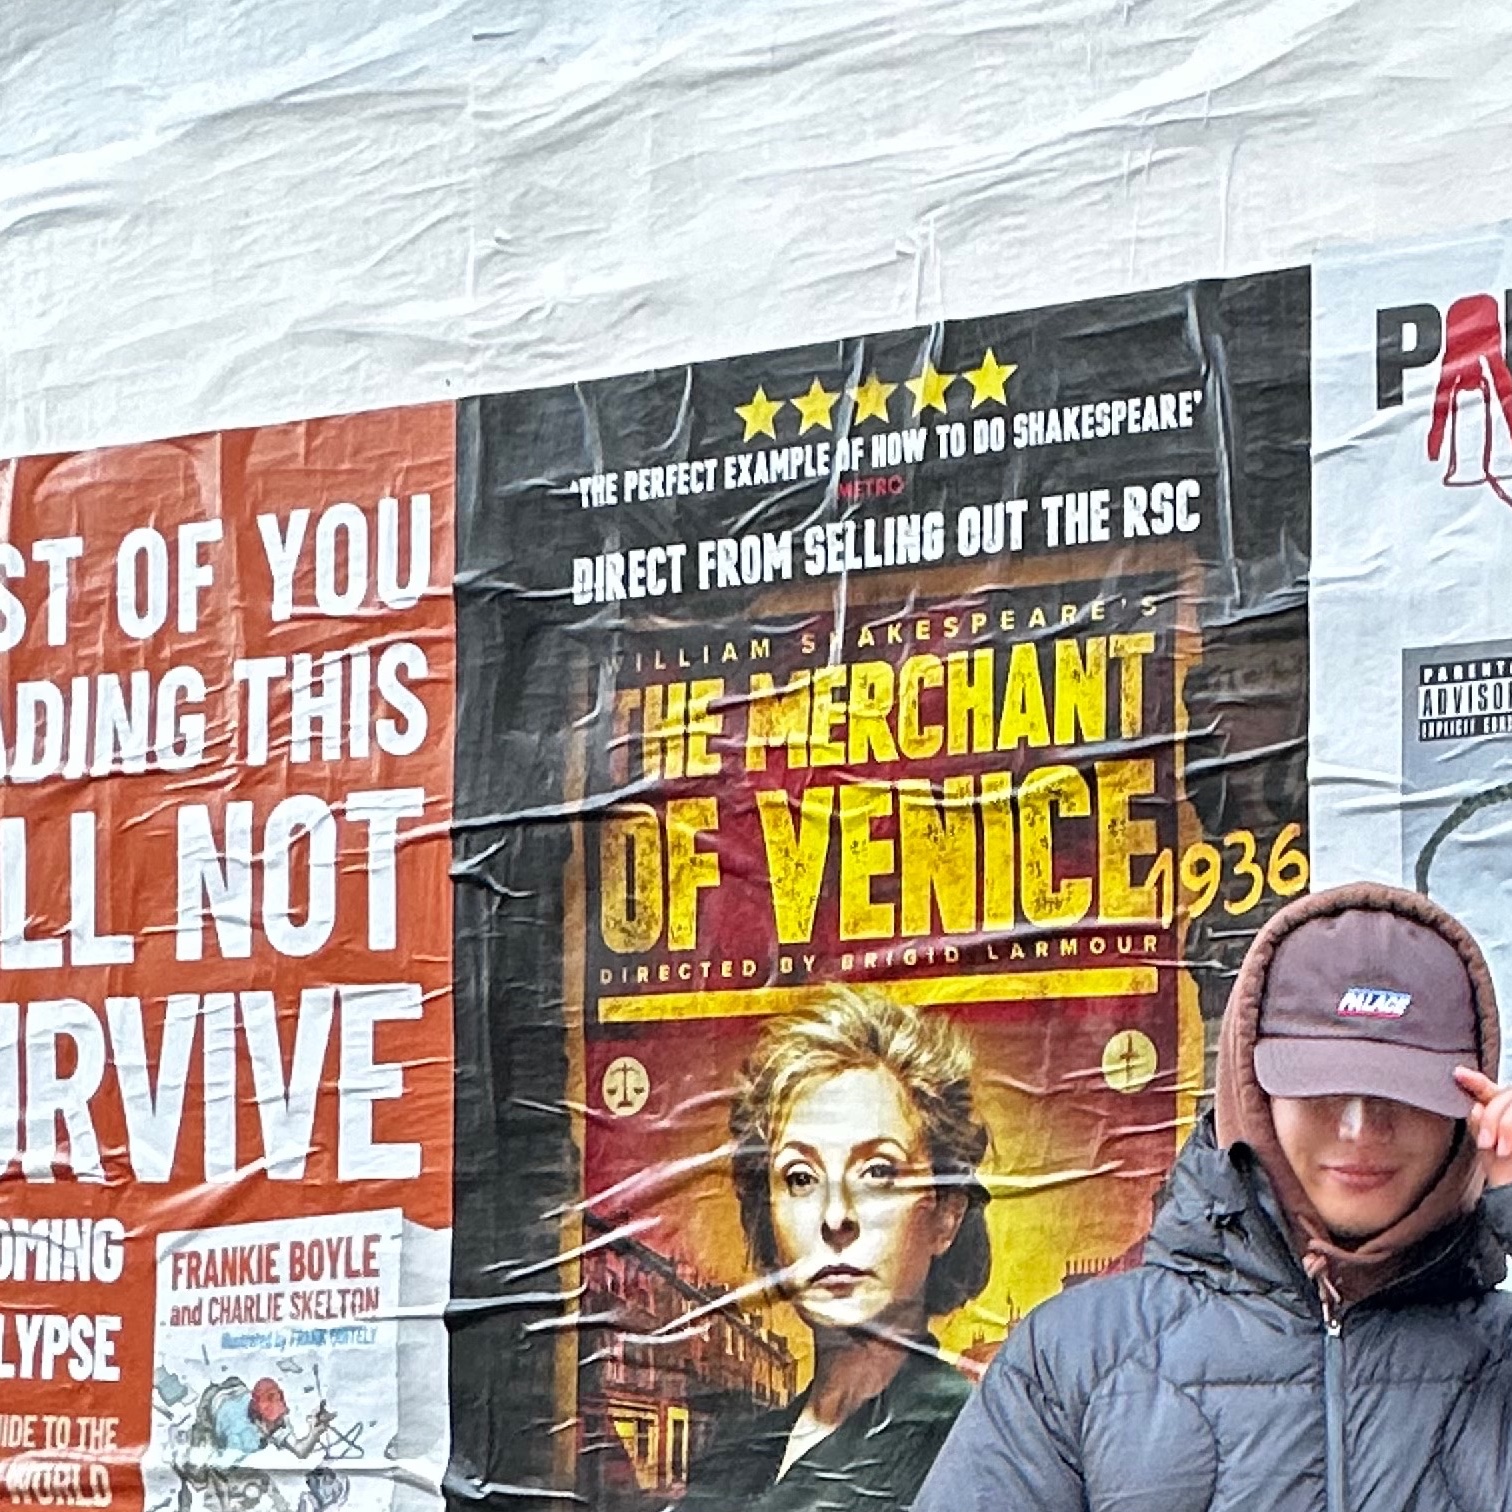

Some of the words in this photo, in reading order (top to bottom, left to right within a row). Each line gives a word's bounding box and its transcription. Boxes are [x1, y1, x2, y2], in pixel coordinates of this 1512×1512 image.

[623, 458, 718, 502] PERFECT
[723, 441, 830, 489] EXAMPLE
[835, 435, 867, 474] OF
[871, 428, 925, 467] HOW
[935, 422, 965, 457] TO
[972, 416, 1005, 452] DO
[837, 475, 904, 500] METRO
[116, 518, 223, 639] OF
[257, 493, 431, 622] YOU
[572, 543, 687, 606] DIRECT
[698, 531, 793, 591] FROM
[804, 512, 945, 576] SELLING
[957, 501, 1028, 555] OUT
[1041, 488, 1110, 547] THE
[1121, 479, 1202, 538] RSC
[0, 665, 206, 783] DING
[234, 642, 429, 766] THIS
[610, 680, 726, 780] THE
[746, 632, 1156, 771] MERCHANT
[176, 788, 424, 961] NOT
[601, 798, 720, 954] OF
[756, 759, 1157, 945] VENICE
[1145, 823, 1309, 929] 1936
[600, 958, 757, 985] DIRECTED
[780, 952, 816, 976] BY
[842, 945, 960, 970] BRIGID
[987, 933, 1160, 961] LARMOUR
[170, 1297, 202, 1326] and
[208, 1292, 284, 1325] CHARLIE
[289, 1286, 380, 1320] SKELTON
[171, 1242, 280, 1291] FRANKIE
[289, 1234, 382, 1282] BOYLE
[0, 1414, 37, 1448] IDE
[42, 1416, 70, 1450] TO
[77, 1417, 119, 1450] THE
[5, 1462, 112, 1507] WORLD
